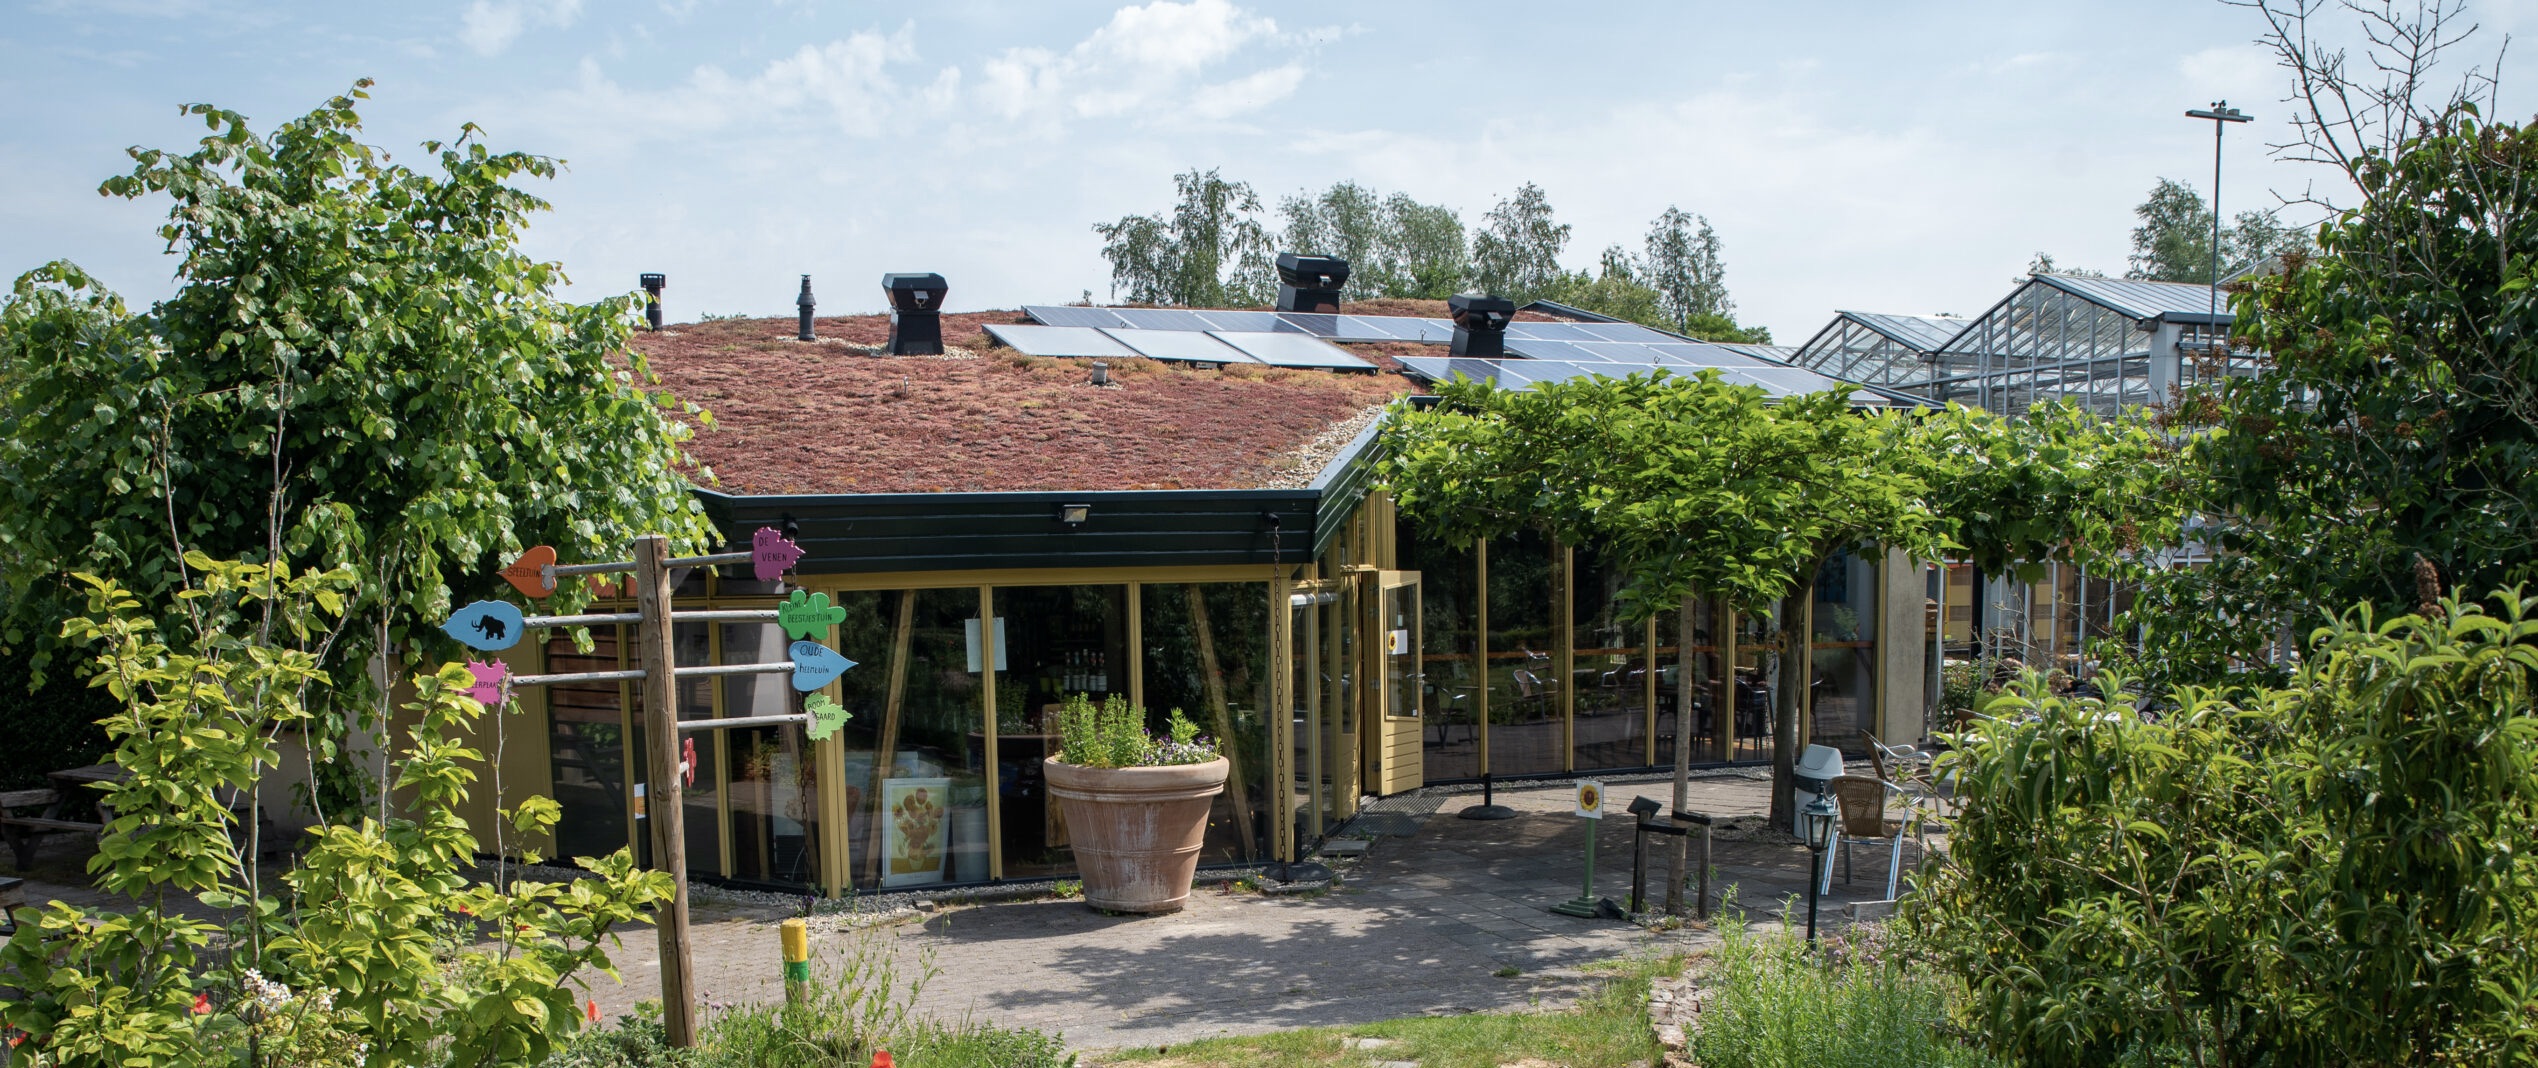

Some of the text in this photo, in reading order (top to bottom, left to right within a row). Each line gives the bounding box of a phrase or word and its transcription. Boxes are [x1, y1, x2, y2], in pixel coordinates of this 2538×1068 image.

[758, 536, 769, 547] DE
[761, 552, 788, 562] VENEN
[799, 644, 823, 657] OUDE
[807, 699, 826, 711] BOOM
